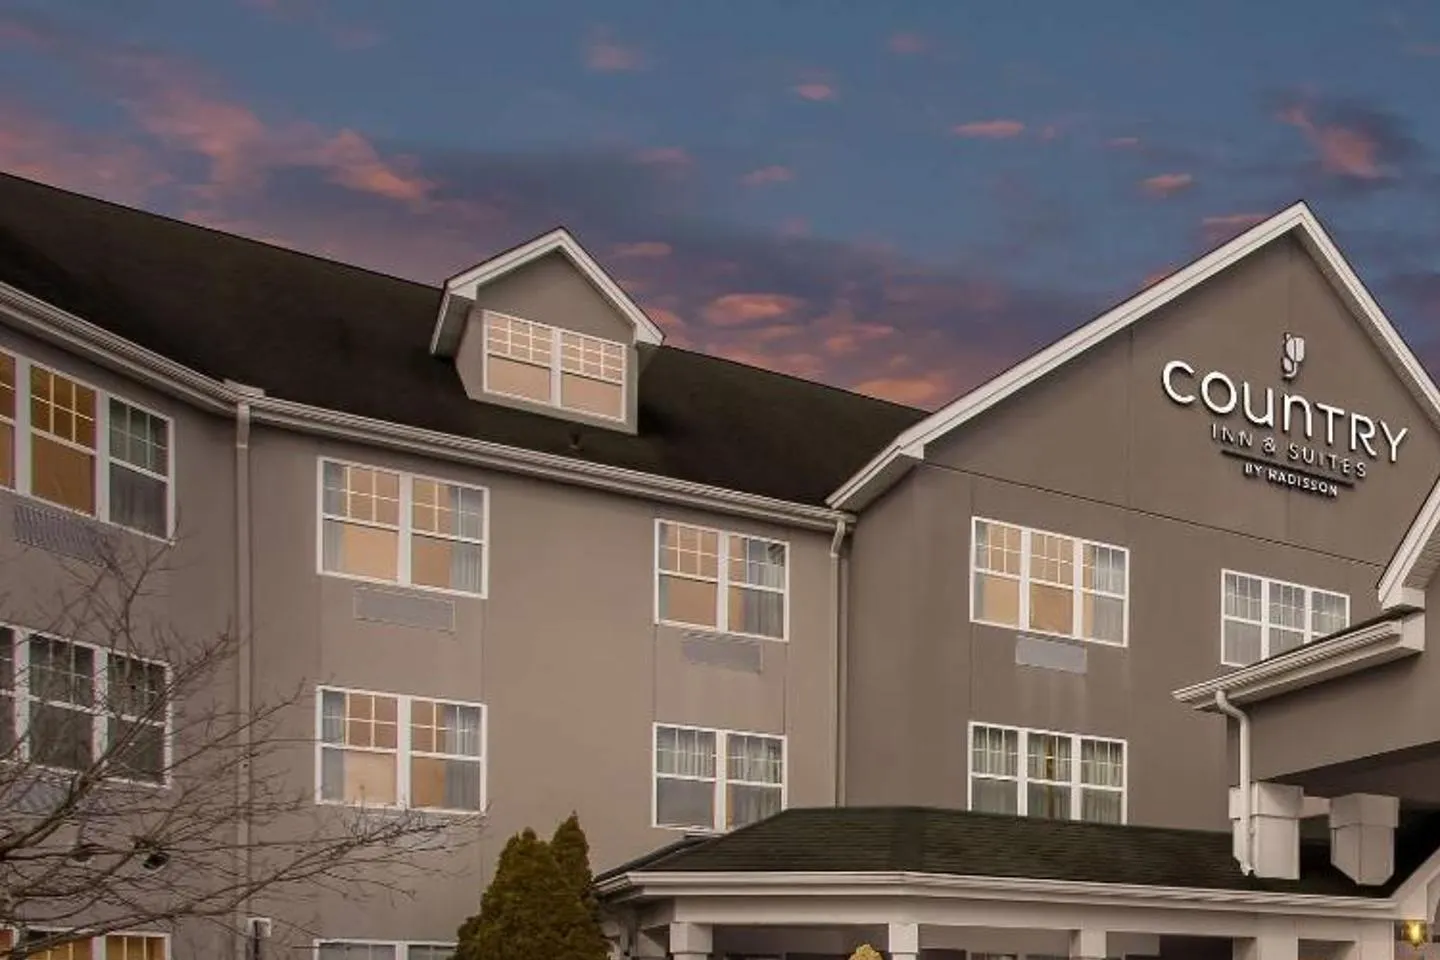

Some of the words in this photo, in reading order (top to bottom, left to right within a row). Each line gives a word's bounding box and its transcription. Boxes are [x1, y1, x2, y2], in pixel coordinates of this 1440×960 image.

[1212, 423, 1253, 447] INN
[1262, 436, 1277, 453] &
[1289, 443, 1367, 478] SUITES
[1245, 463, 1263, 477] BY
[1268, 468, 1338, 497] RADISSON
